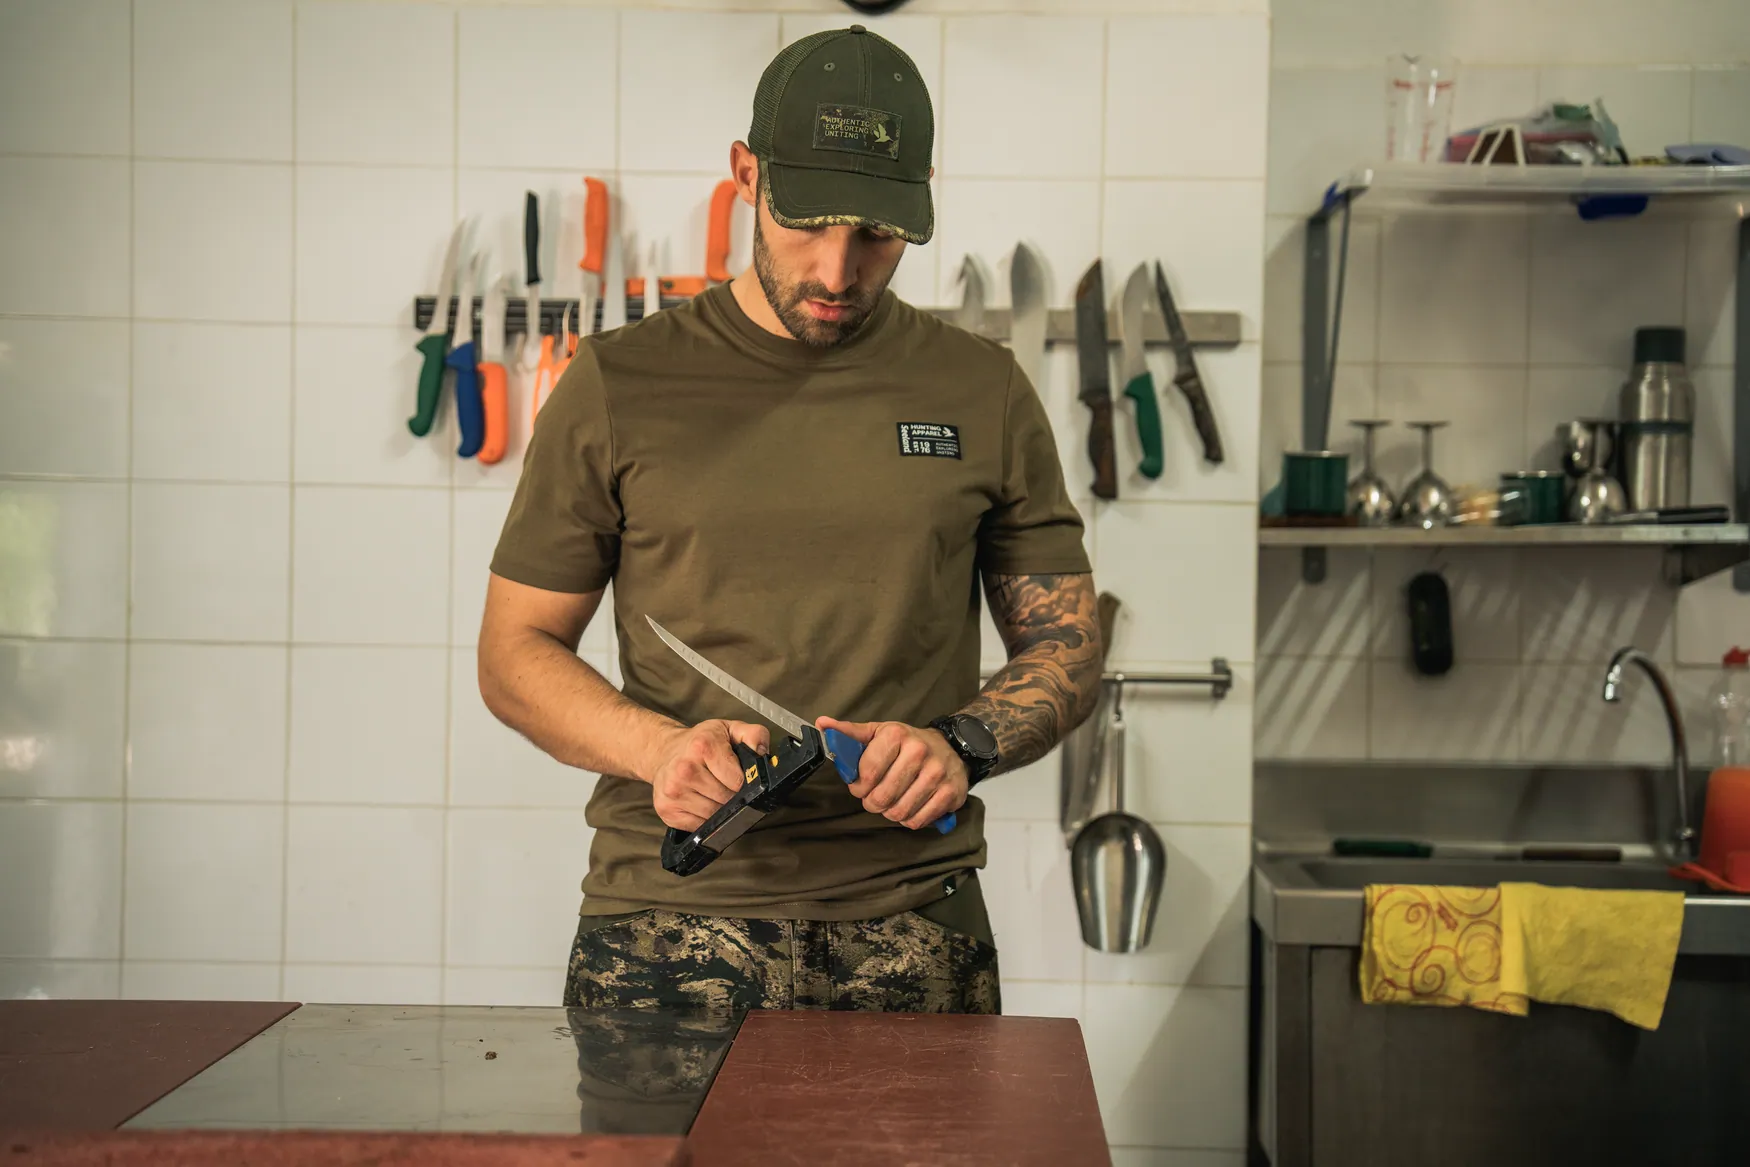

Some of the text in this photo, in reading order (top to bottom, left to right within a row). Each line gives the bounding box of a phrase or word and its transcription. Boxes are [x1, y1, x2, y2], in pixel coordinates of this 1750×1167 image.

[827, 117, 870, 127] AUTHENTIC
[826, 124, 869, 134] EXPLORING
[825, 130, 858, 139] UNITING
[901, 424, 912, 453] Seeland
